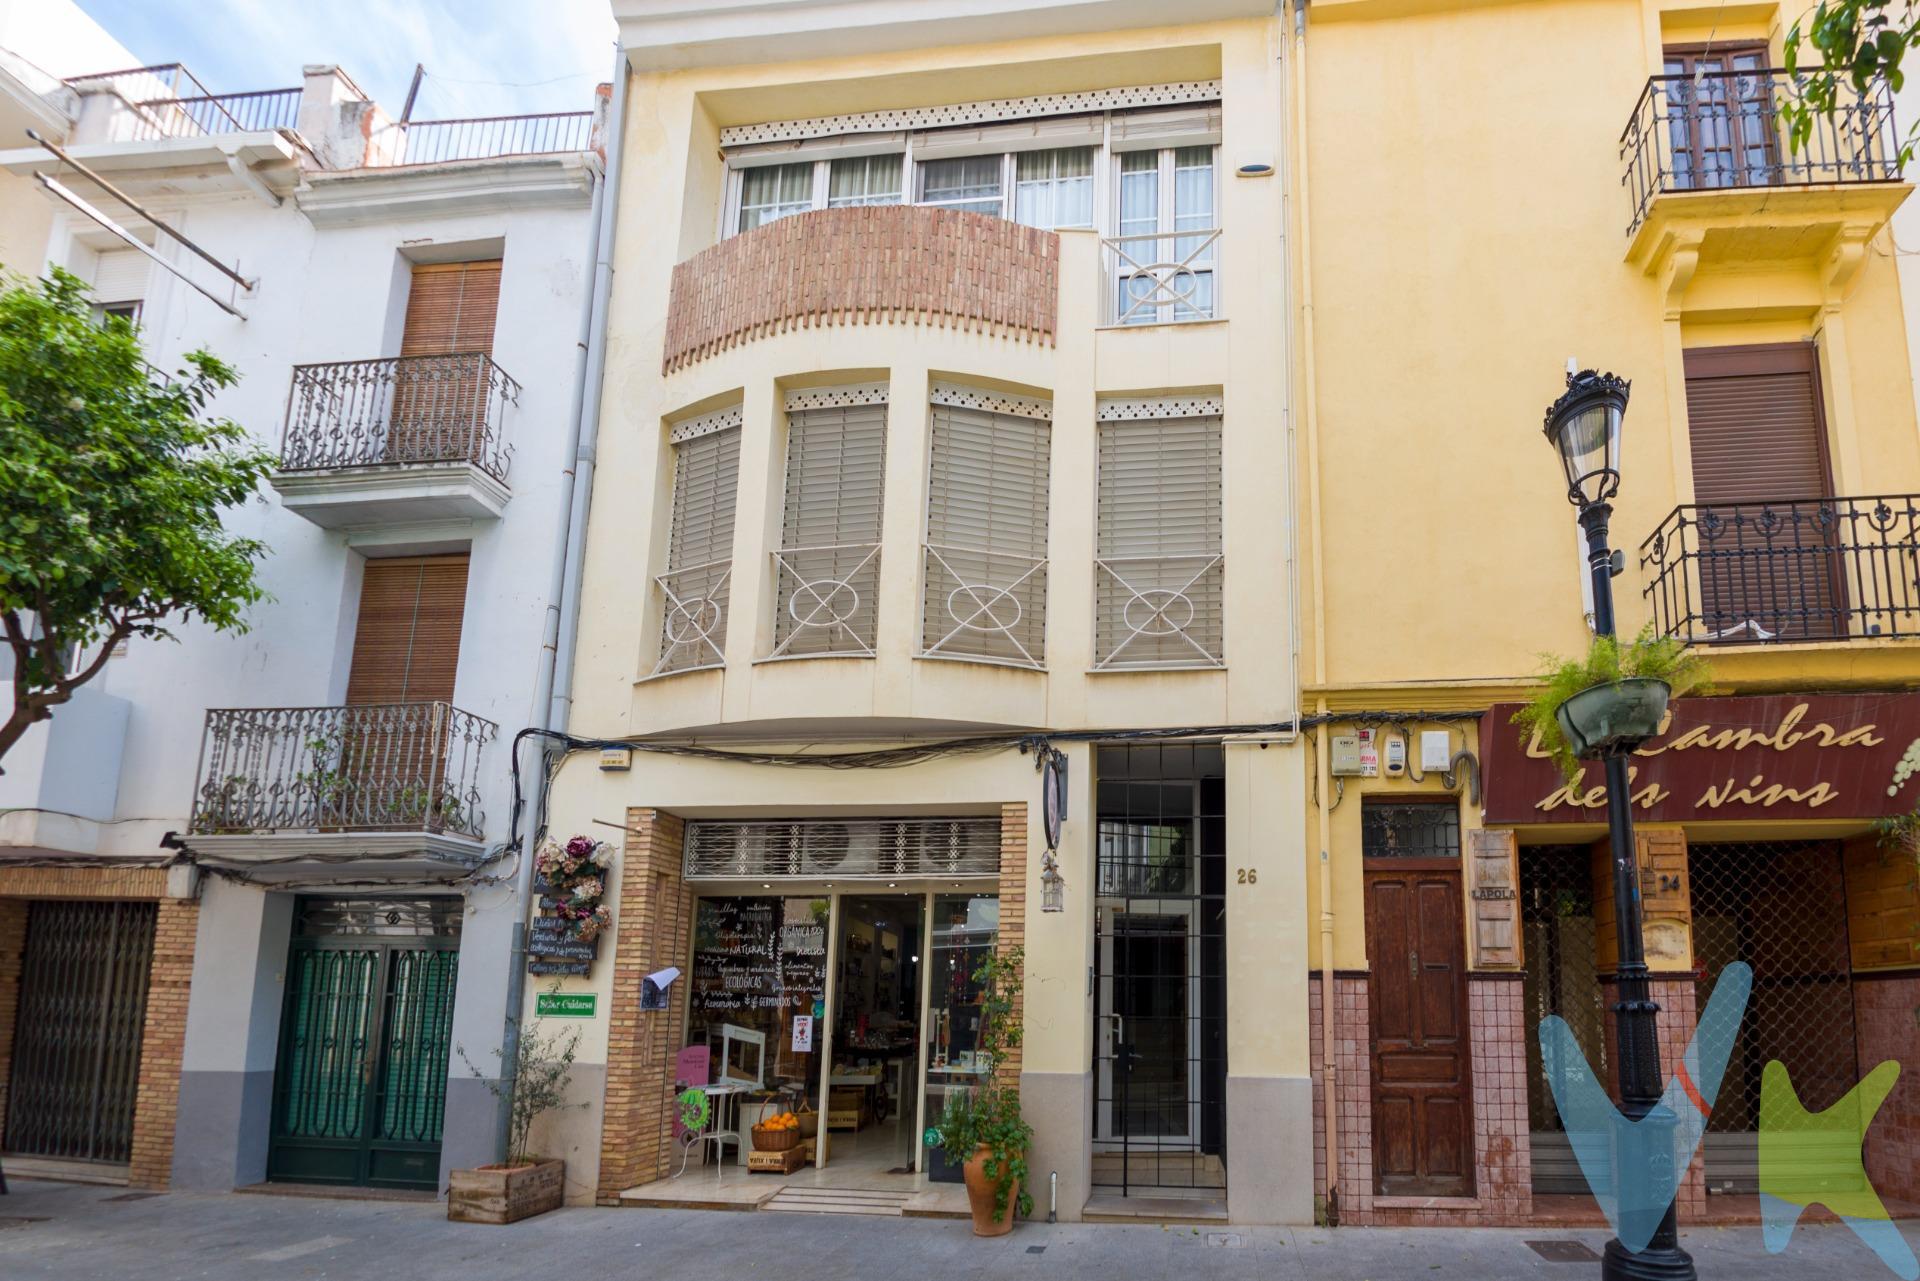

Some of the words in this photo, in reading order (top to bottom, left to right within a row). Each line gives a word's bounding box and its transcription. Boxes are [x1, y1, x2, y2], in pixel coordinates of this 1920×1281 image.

[1237, 868, 1257, 884] 26
[779, 925, 810, 938] ORGÁNICA
[730, 943, 767, 956] NATURAL
[725, 974, 762, 989] ECOLÓGICAS
[759, 996, 791, 1008] GERMINADOS
